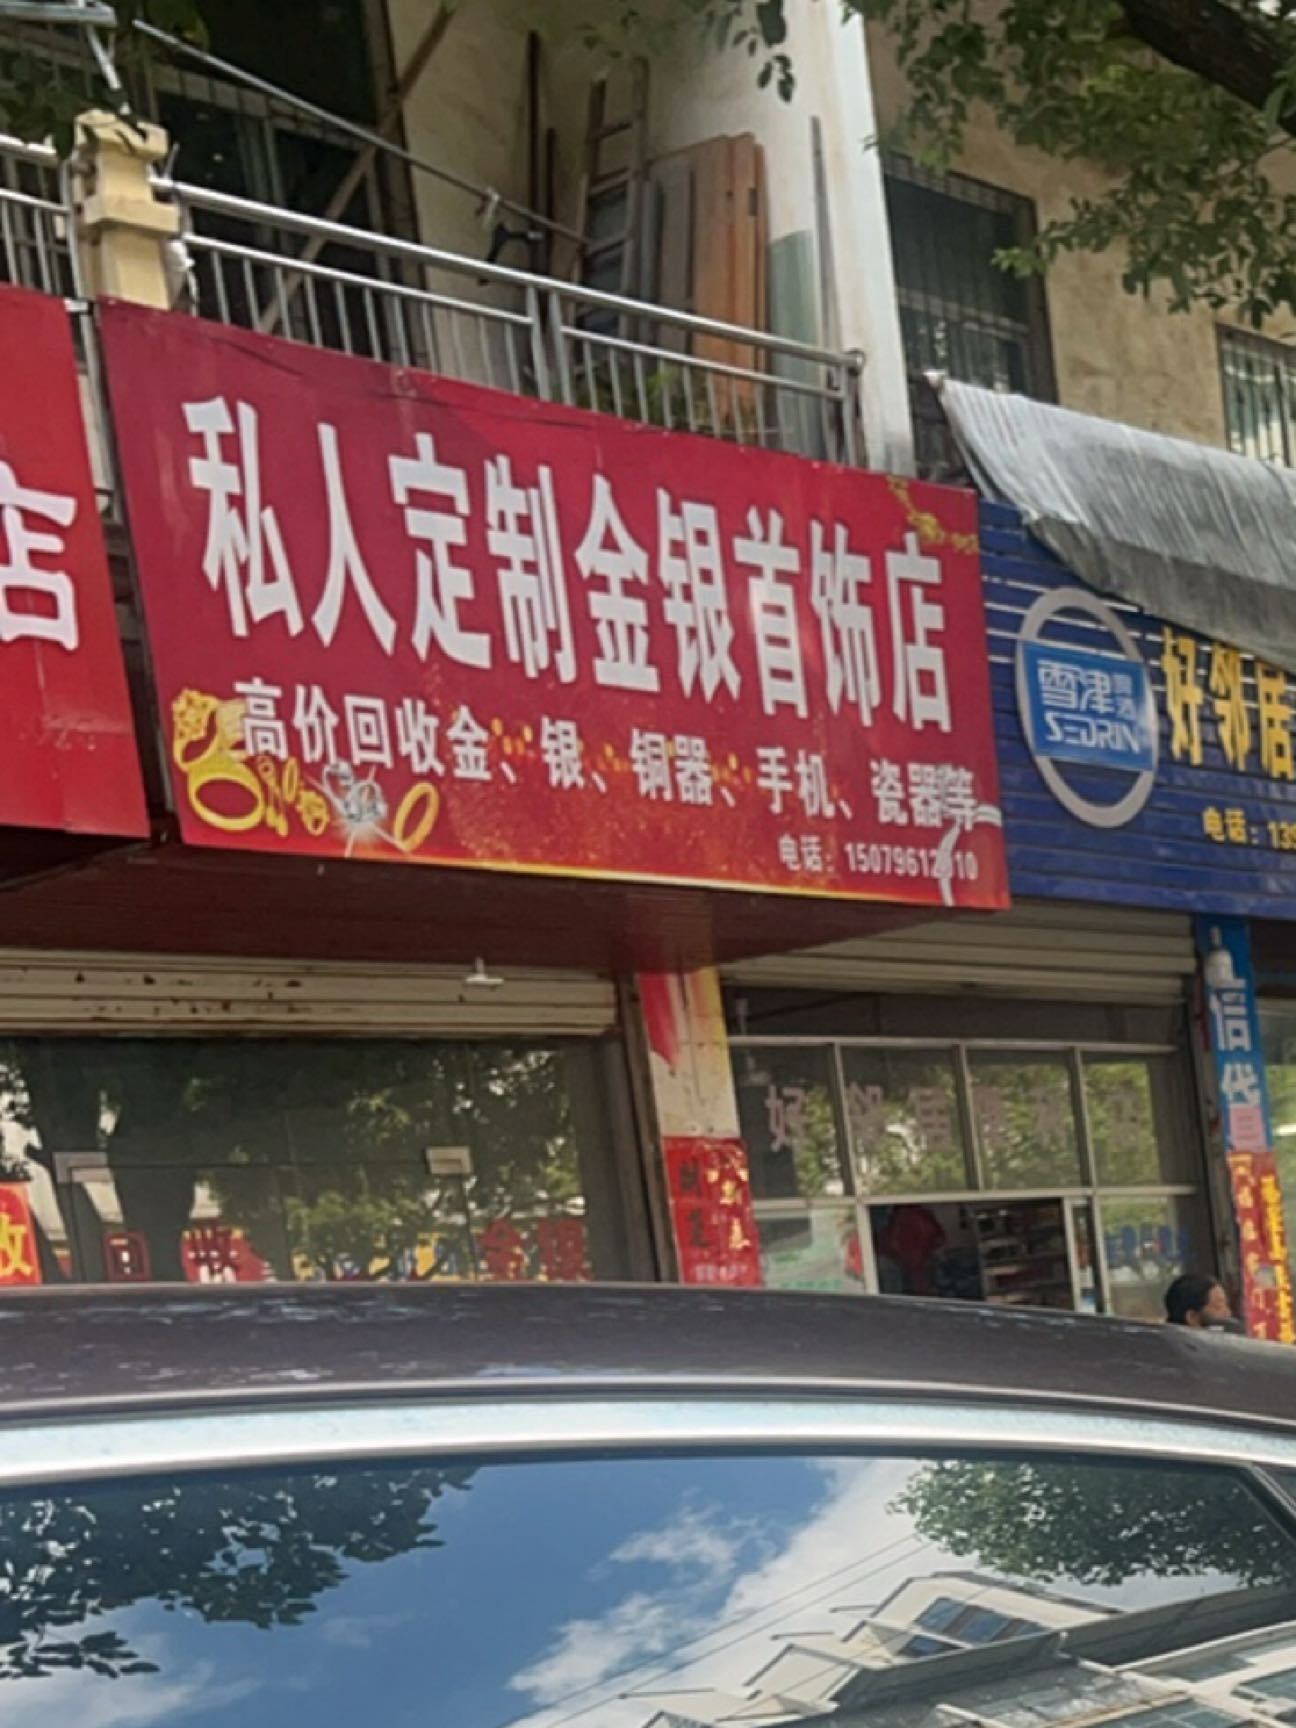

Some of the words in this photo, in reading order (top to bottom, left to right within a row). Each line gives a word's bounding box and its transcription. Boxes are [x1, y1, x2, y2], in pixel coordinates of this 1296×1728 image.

[0, 461, 79, 651] 店
[183, 396, 952, 734] 私人定制金银首饰店
[1037, 660, 1115, 713] 雪津
[1044, 711, 1140, 754] SEDRIN
